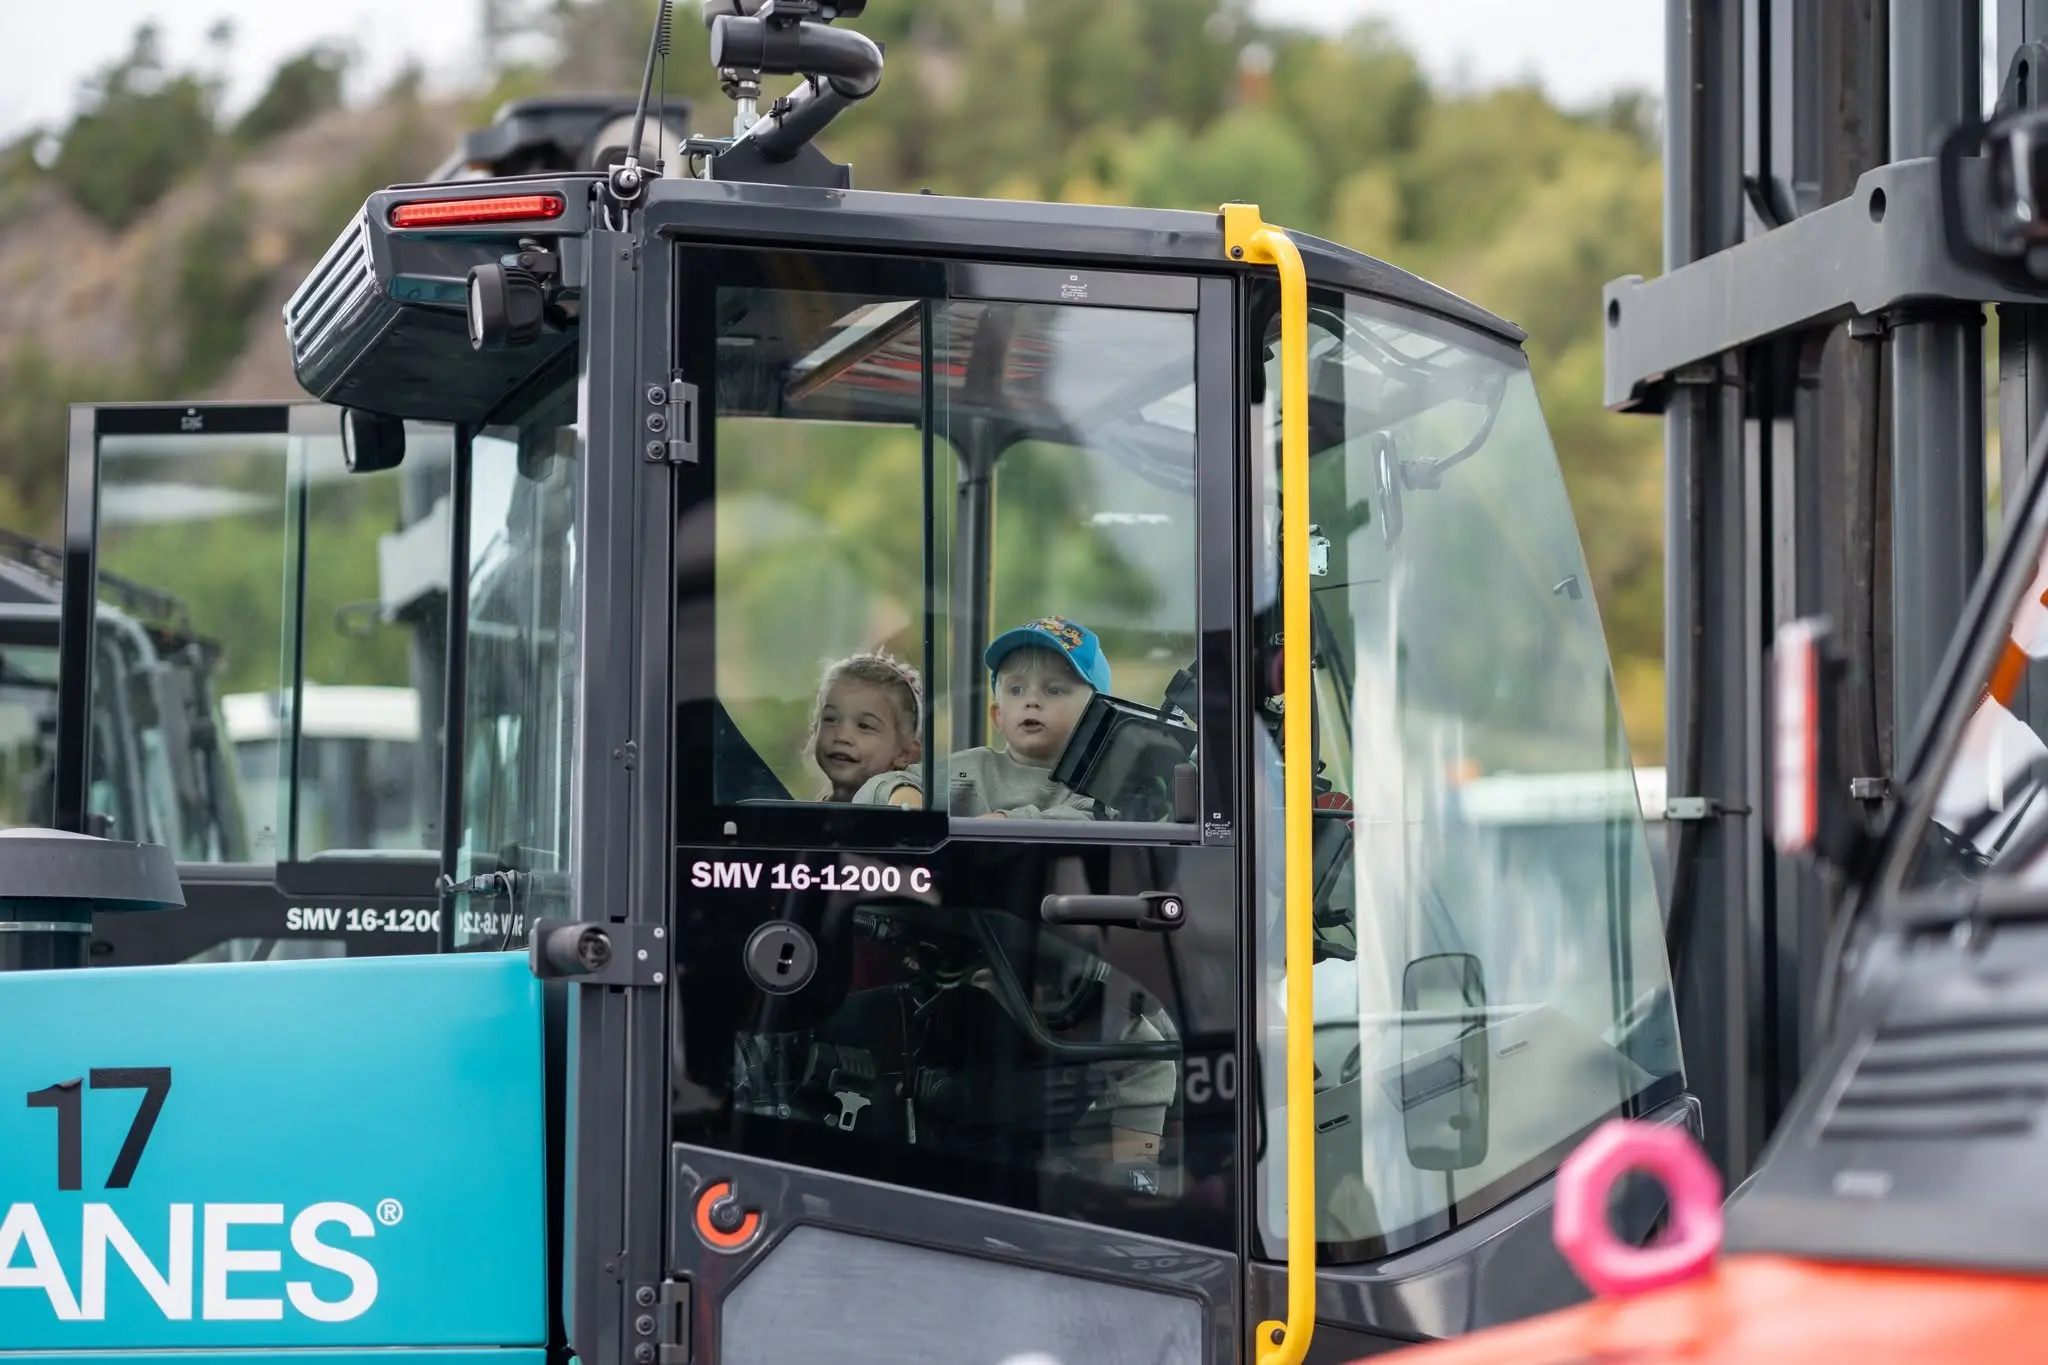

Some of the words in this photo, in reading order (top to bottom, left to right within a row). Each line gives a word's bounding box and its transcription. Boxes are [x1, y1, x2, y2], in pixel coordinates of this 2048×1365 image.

[690, 861, 763, 889] SMV
[771, 864, 901, 892] 16-1200
[910, 867, 932, 893] C
[286, 907, 341, 931] SMV
[27, 1067, 171, 1191] 17
